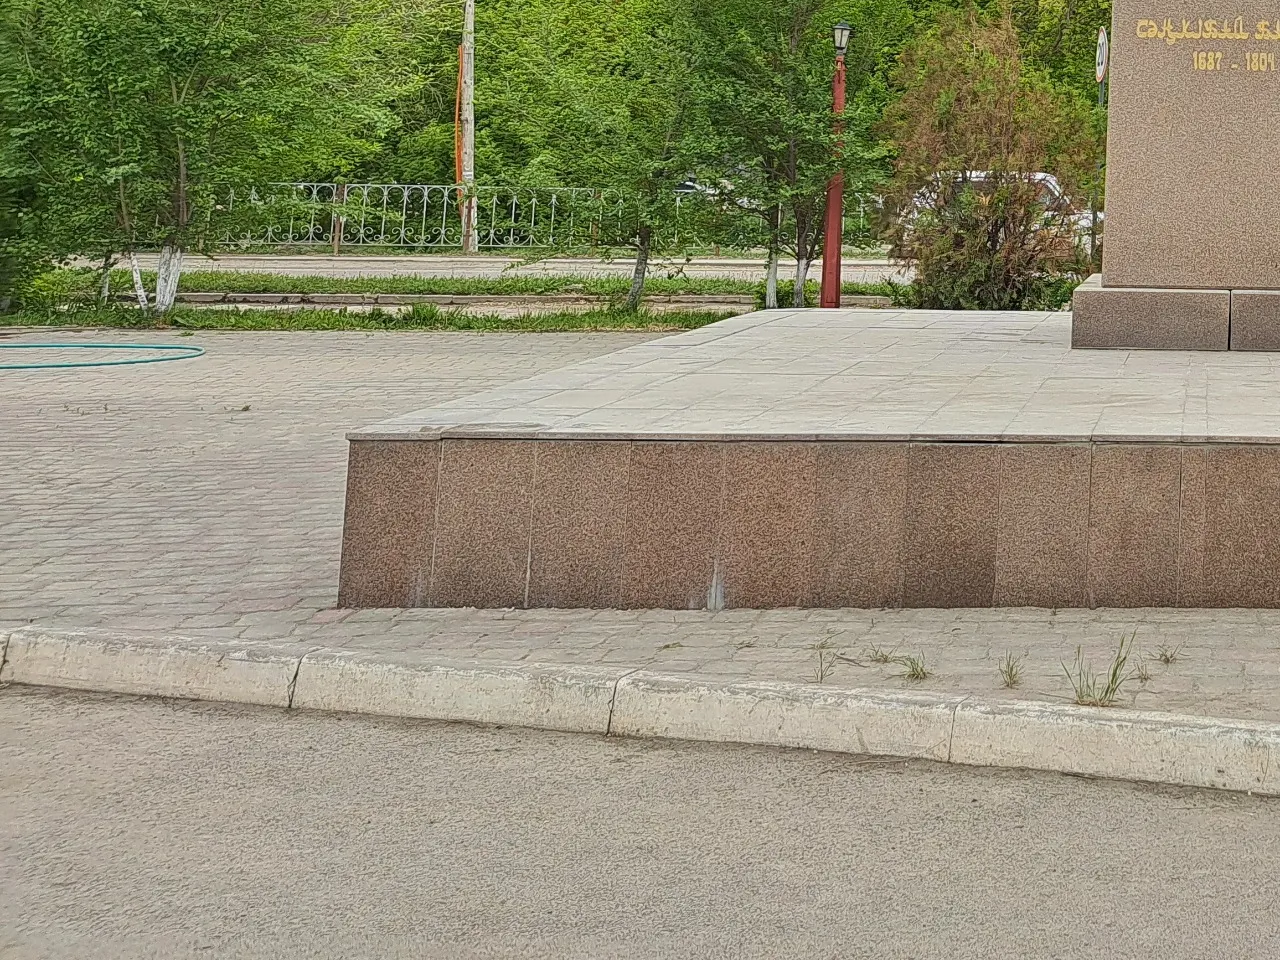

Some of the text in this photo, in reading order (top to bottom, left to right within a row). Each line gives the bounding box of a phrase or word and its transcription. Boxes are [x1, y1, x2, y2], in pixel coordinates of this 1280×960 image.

[1097, 41, 1105, 66] 20
[1193, 51, 1223, 71] 1687
[1246, 52, 1276, 71] 1804
